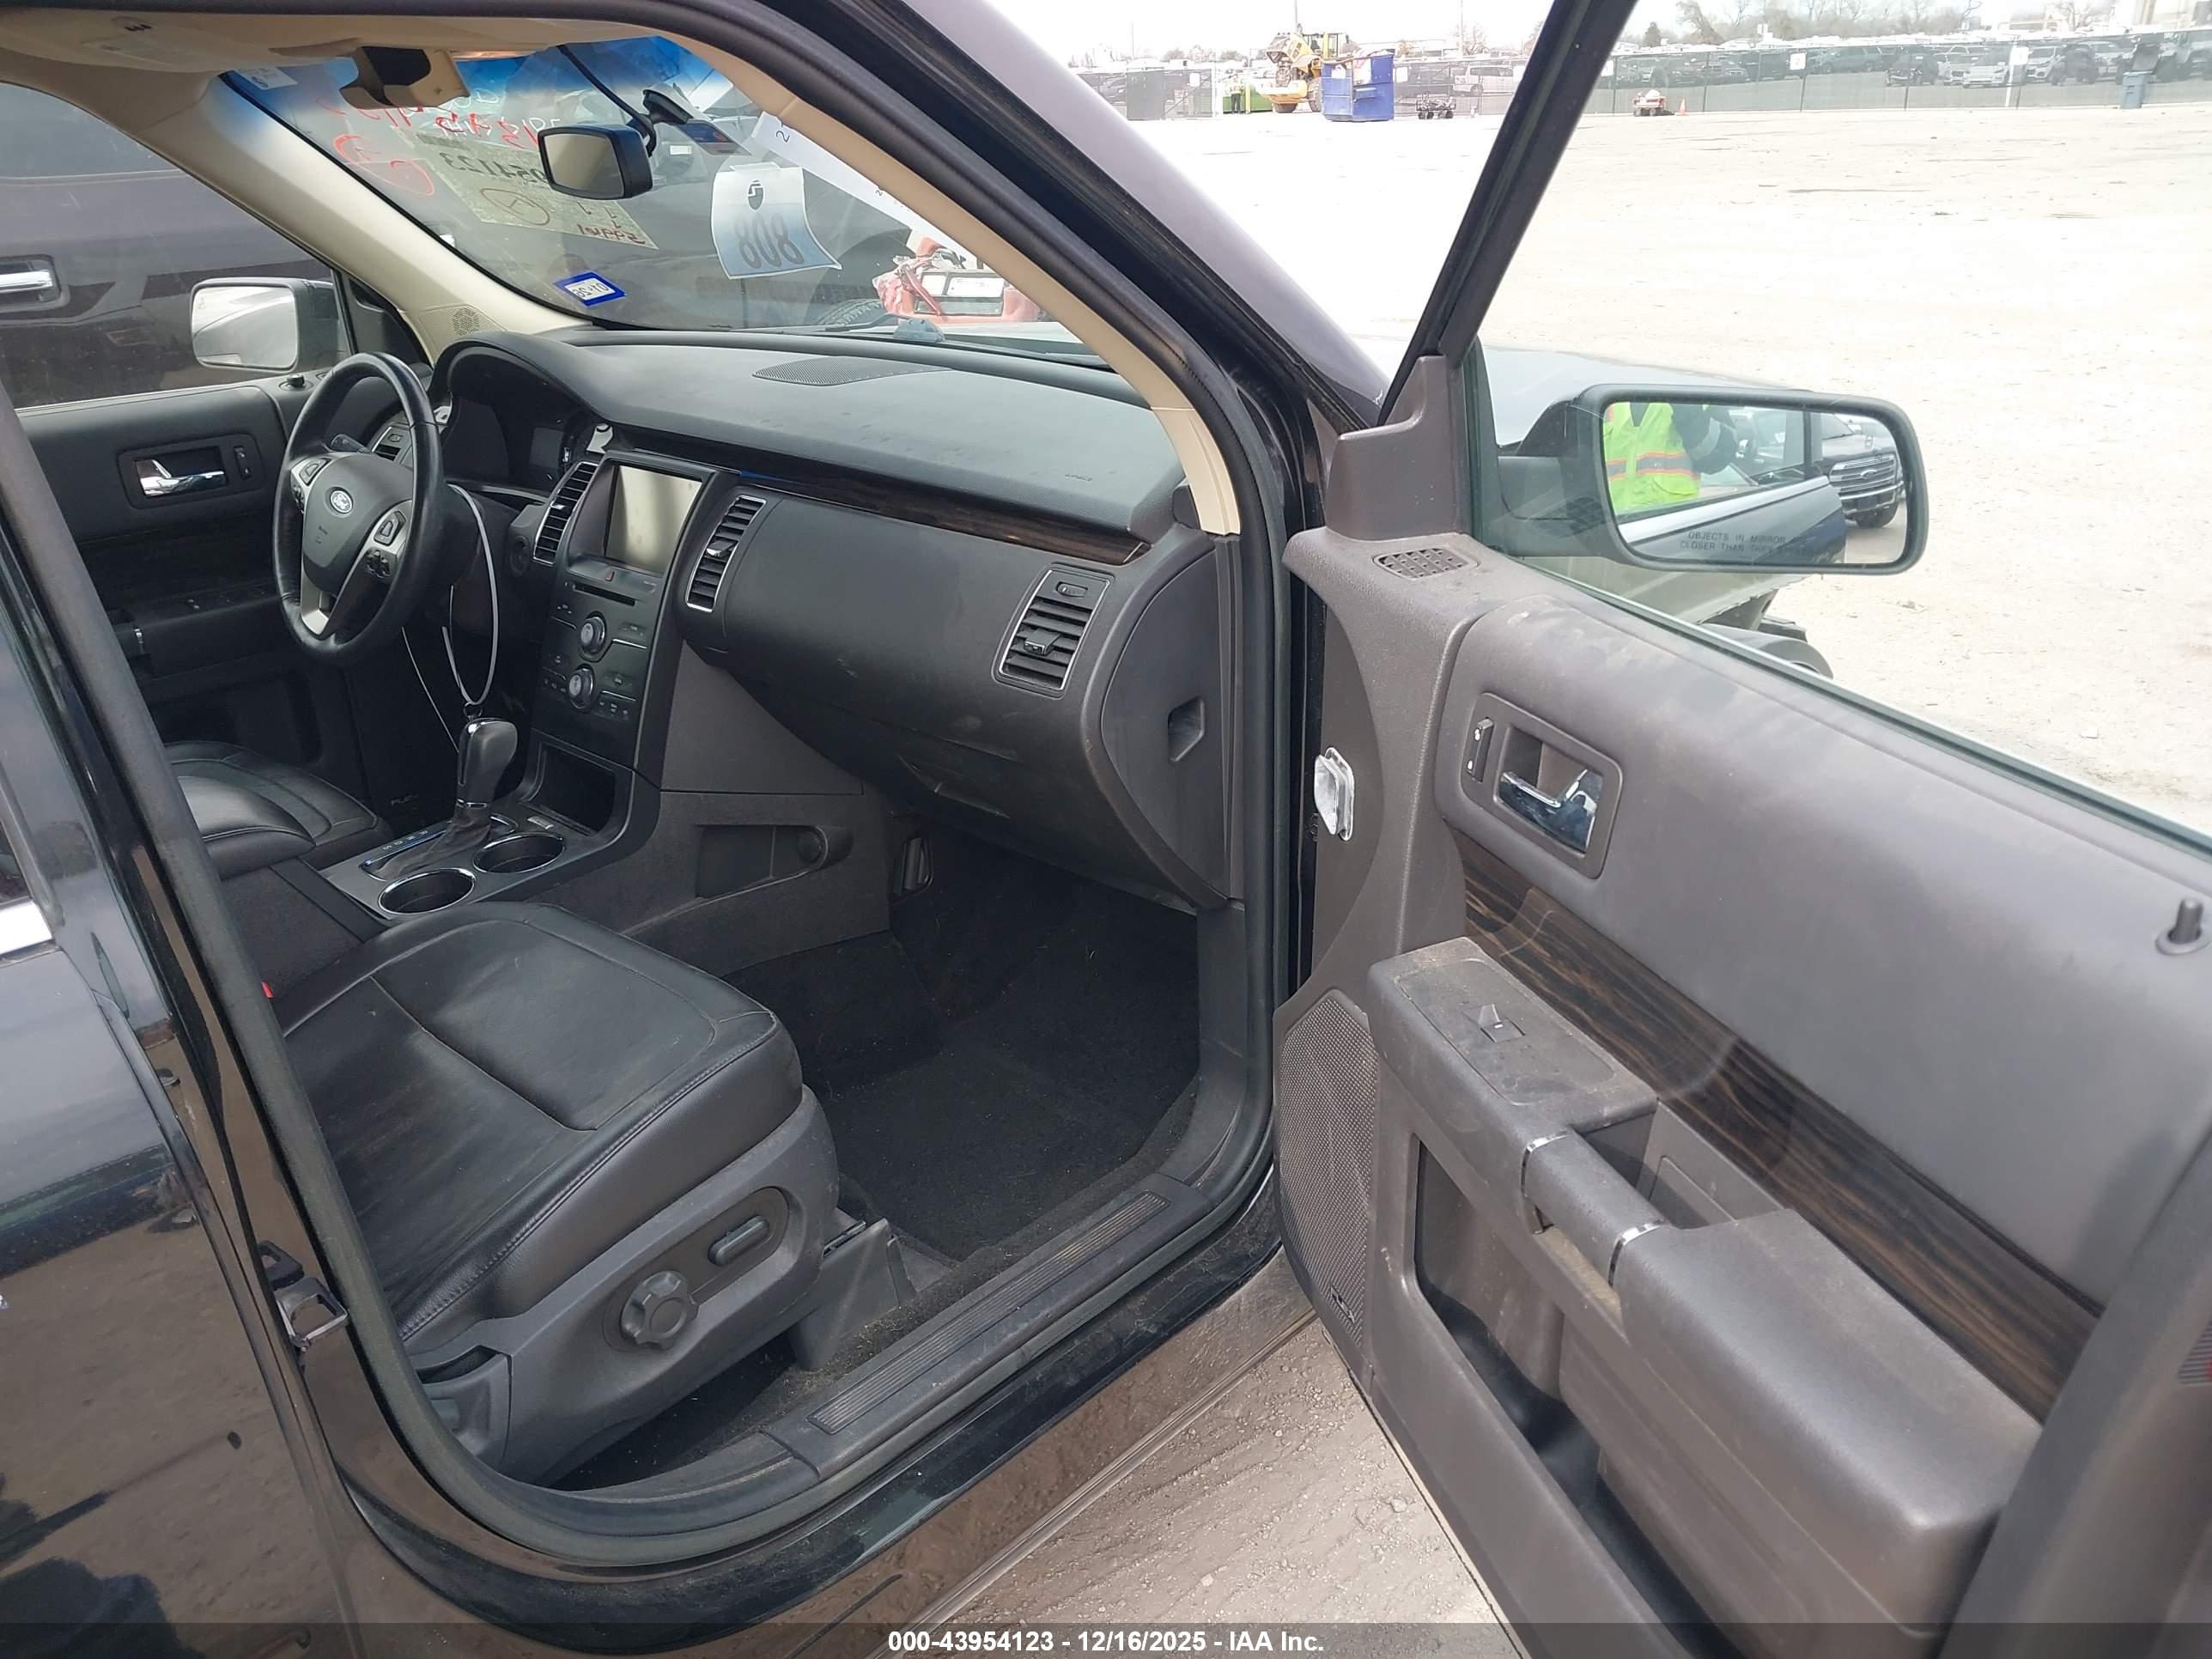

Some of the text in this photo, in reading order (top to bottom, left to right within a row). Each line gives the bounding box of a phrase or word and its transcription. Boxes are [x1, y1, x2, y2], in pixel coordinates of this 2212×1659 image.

[733, 211, 805, 270] 808
[1687, 531, 1729, 542] OBJECTS
[1735, 533, 1745, 542] IN
[1750, 535, 1786, 544] MIRROR
[1679, 540, 1716, 550] CLOSER
[1721, 543, 1745, 551] THAN
